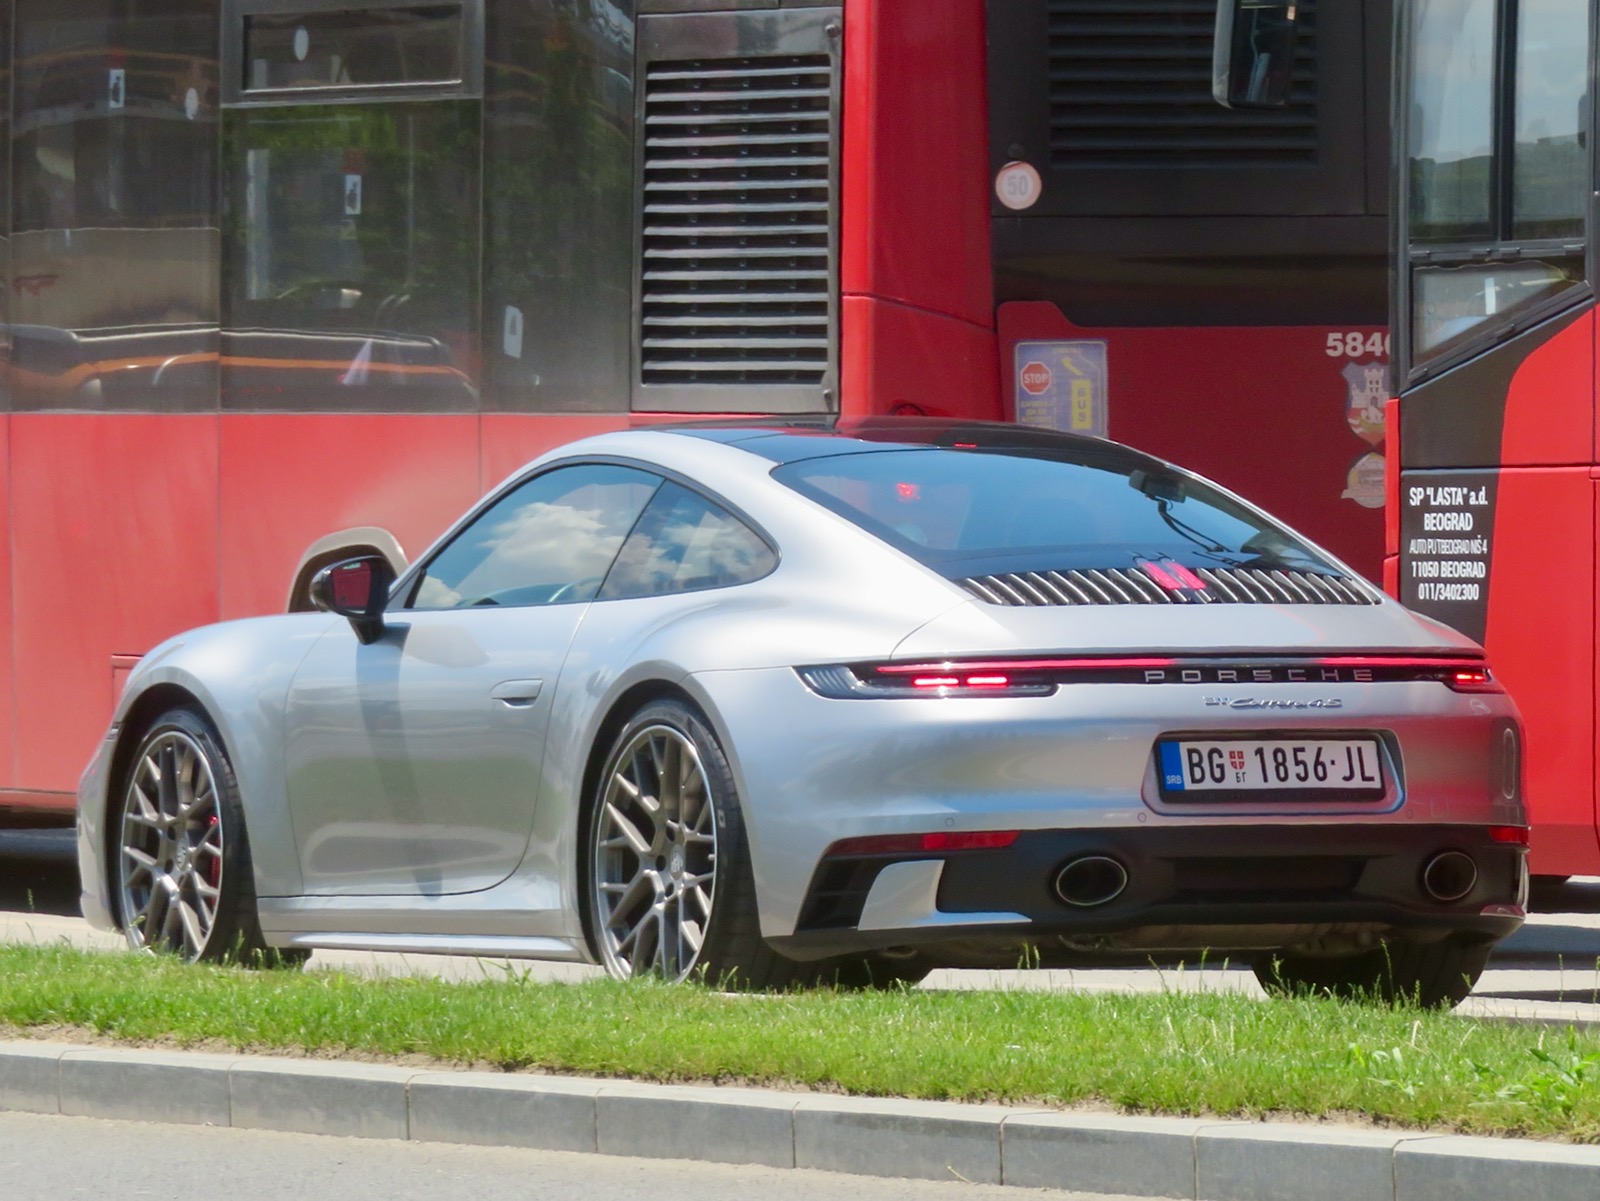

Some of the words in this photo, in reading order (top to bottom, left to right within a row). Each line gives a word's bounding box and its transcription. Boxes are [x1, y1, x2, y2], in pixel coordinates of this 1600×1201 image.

[1007, 175, 1028, 196] 50
[1023, 373, 1048, 384] STOP
[1077, 387, 1086, 422] BUS
[1409, 487, 1424, 506] SP
[1426, 487, 1468, 506] "LASTA"
[1469, 486, 1488, 505] a.d.
[1424, 513, 1473, 531] BEOGRAD
[1482, 539, 1488, 554] 4
[1411, 561, 1439, 577] 11050
[1440, 561, 1486, 578] BEOGRAD
[1418, 583, 1479, 600] 011/3402300
[1144, 669, 1374, 683] PORSCHE
[1187, 747, 1225, 784] BG
[1166, 775, 1182, 785] SRB
